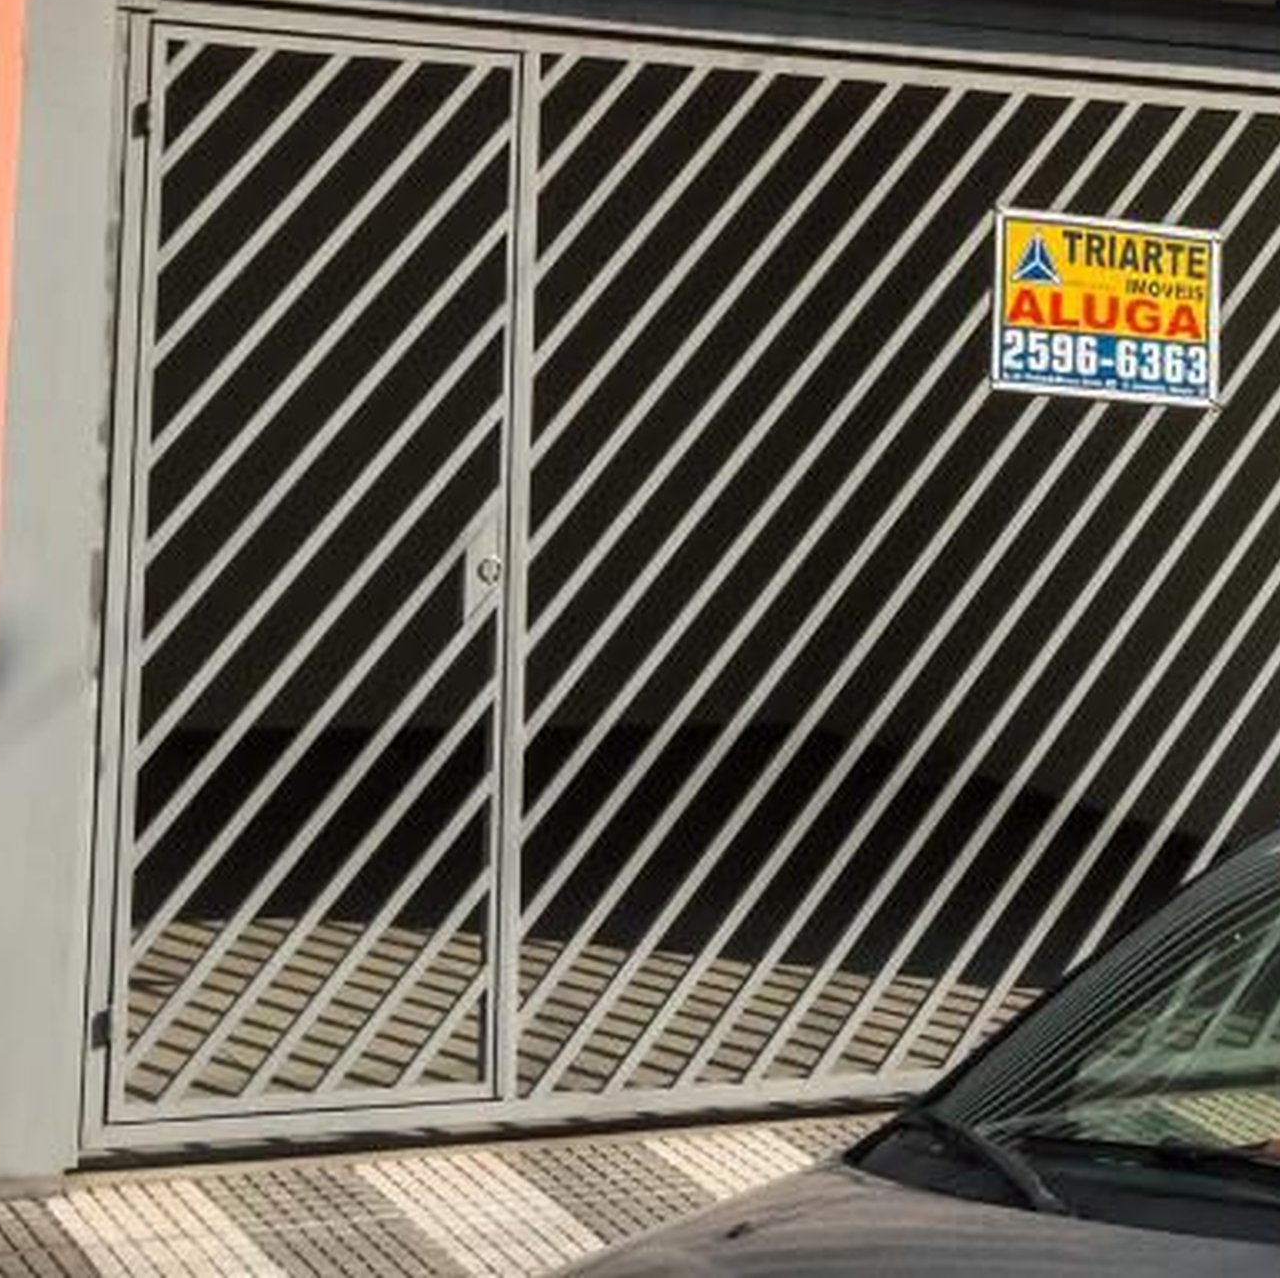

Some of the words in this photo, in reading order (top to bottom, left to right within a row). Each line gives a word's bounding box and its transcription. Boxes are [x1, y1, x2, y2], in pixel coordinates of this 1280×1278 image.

[1062, 229, 1207, 280] TRIARTE
[1008, 288, 1202, 340] ALUGA
[1002, 329, 1208, 385] 2596-6363
